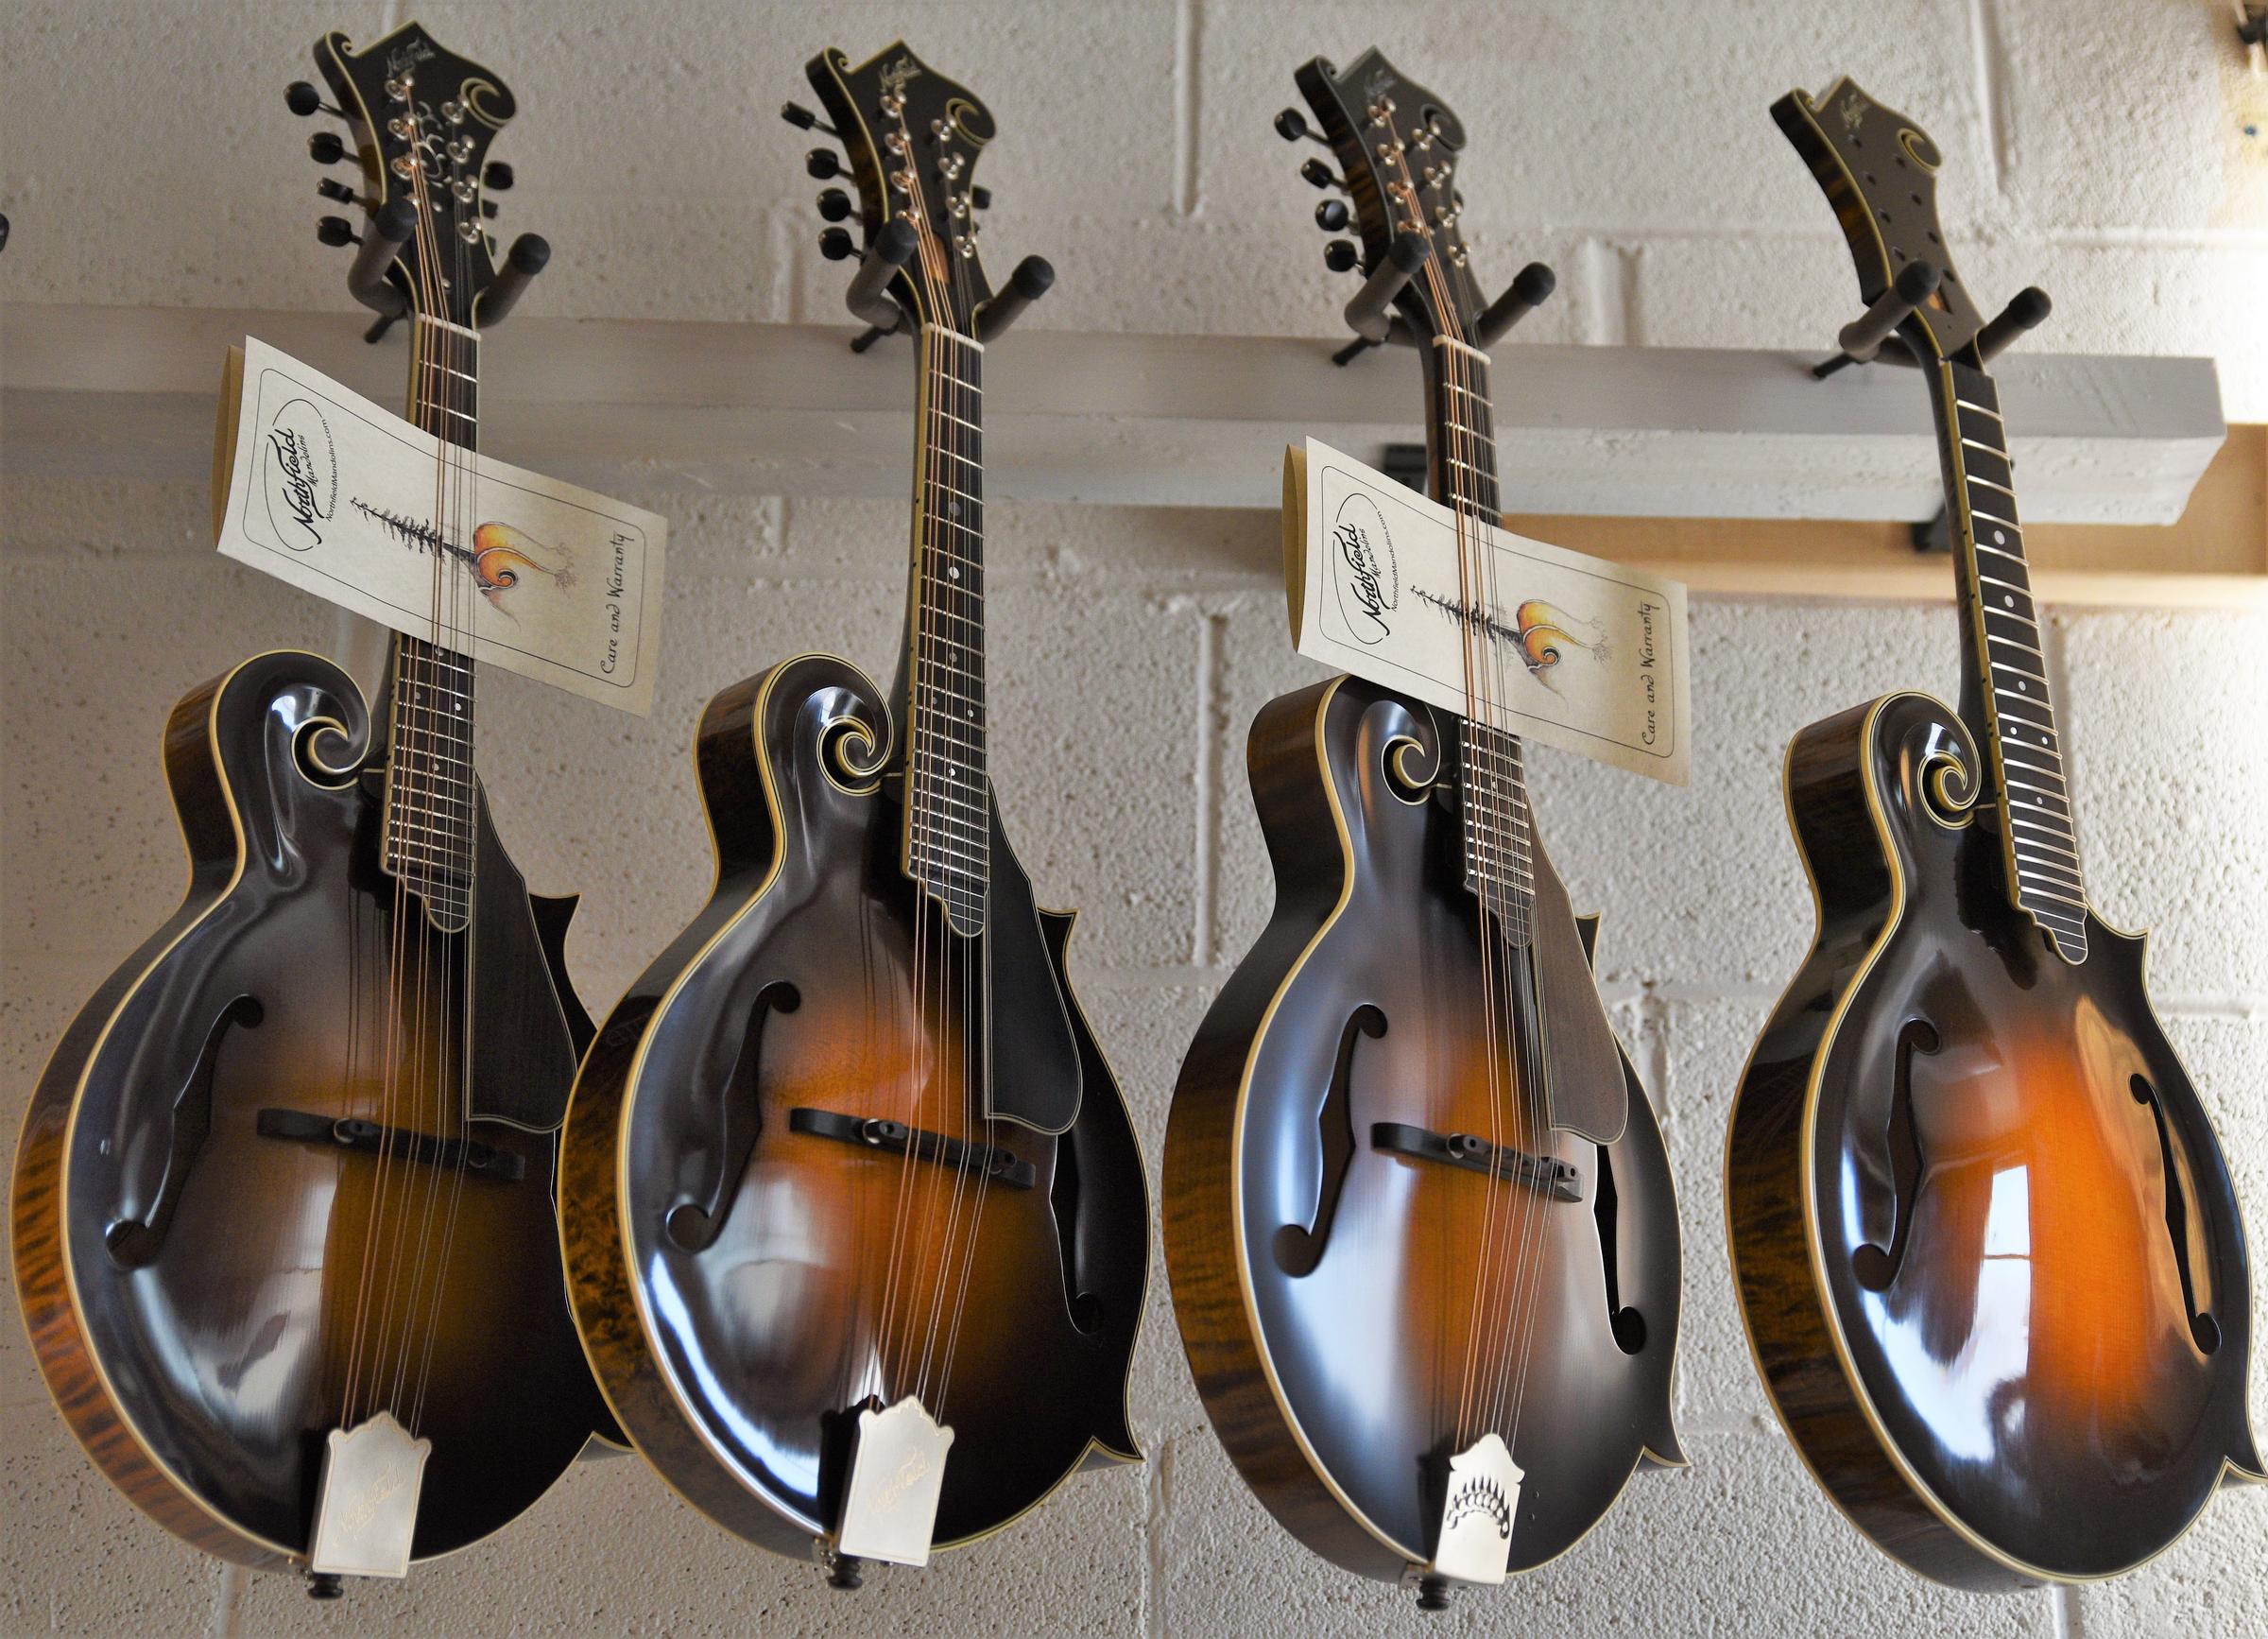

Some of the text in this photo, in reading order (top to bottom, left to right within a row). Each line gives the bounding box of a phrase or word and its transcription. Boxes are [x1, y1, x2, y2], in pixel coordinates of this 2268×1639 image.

[267, 428, 324, 545] Northfield
[298, 434, 318, 487] Mandolins
[321, 419, 338, 522] NorthfieldMandolins.com
[600, 529, 634, 674] Care and Warranty
[1333, 523, 1390, 636] Northfield
[1359, 527, 1382, 579] Mandolins
[1377, 510, 1399, 612] NorthfieldMandolins.com
[1638, 600, 1660, 745] Care and Warranty
